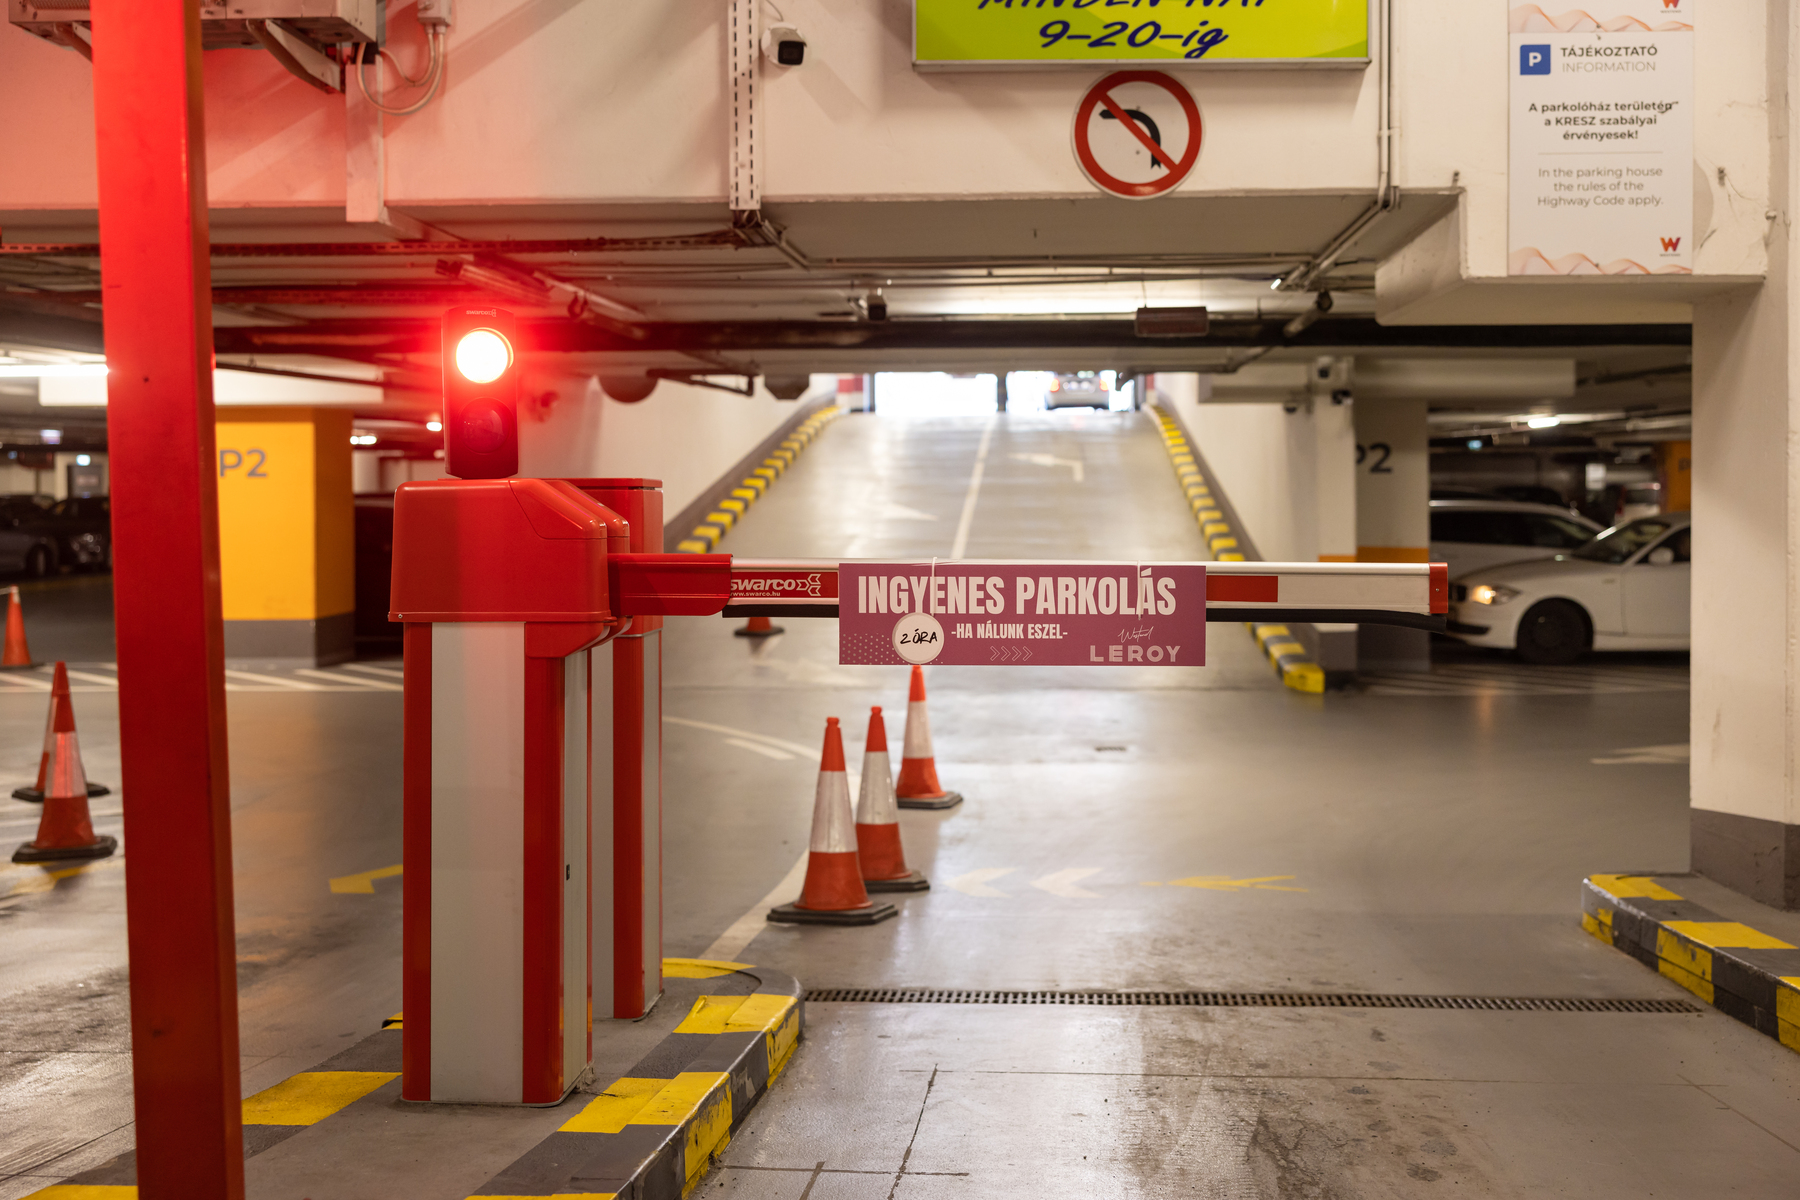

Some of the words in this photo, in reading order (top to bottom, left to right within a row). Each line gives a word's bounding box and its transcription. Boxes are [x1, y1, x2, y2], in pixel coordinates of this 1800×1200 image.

[1039, 20, 1229, 59] 9-20-ig
[1560, 44, 1658, 58] TÁJÉKOZTATÓ
[1529, 52, 1542, 67] P
[1562, 61, 1656, 73] INFORMATION
[1529, 103, 1538, 112] A
[1541, 101, 1611, 114] parkolóház
[1544, 118, 1551, 126] a
[1555, 116, 1596, 126] KRESZ
[1599, 115, 1657, 127] szabályai
[1563, 130, 1639, 142] érvényesek!
[1538, 168, 1550, 178] In
[1553, 167, 1573, 178] the
[1576, 167, 1623, 179] parking
[1626, 167, 1663, 177] house
[1553, 183, 1574, 192] the
[1577, 182, 1606, 192] rules
[1609, 181, 1621, 191] of
[1624, 181, 1644, 191] the
[1537, 197, 1591, 208] Highway
[1593, 195, 1625, 206] Code
[1628, 195, 1664, 207] apply.
[1660, 237, 1681, 252] W
[219, 448, 268, 477] P2
[731, 579, 796, 591] swarco
[858, 575, 1005, 615] INGYENES
[1016, 567, 1177, 615] PARKOLÁS
[976, 619, 1024, 639] NÁLUNK
[1027, 623, 1068, 639] ESZEL-
[900, 633, 911, 644] 2
[912, 628, 938, 645] ÓRA
[1089, 645, 1181, 662] LEROY
